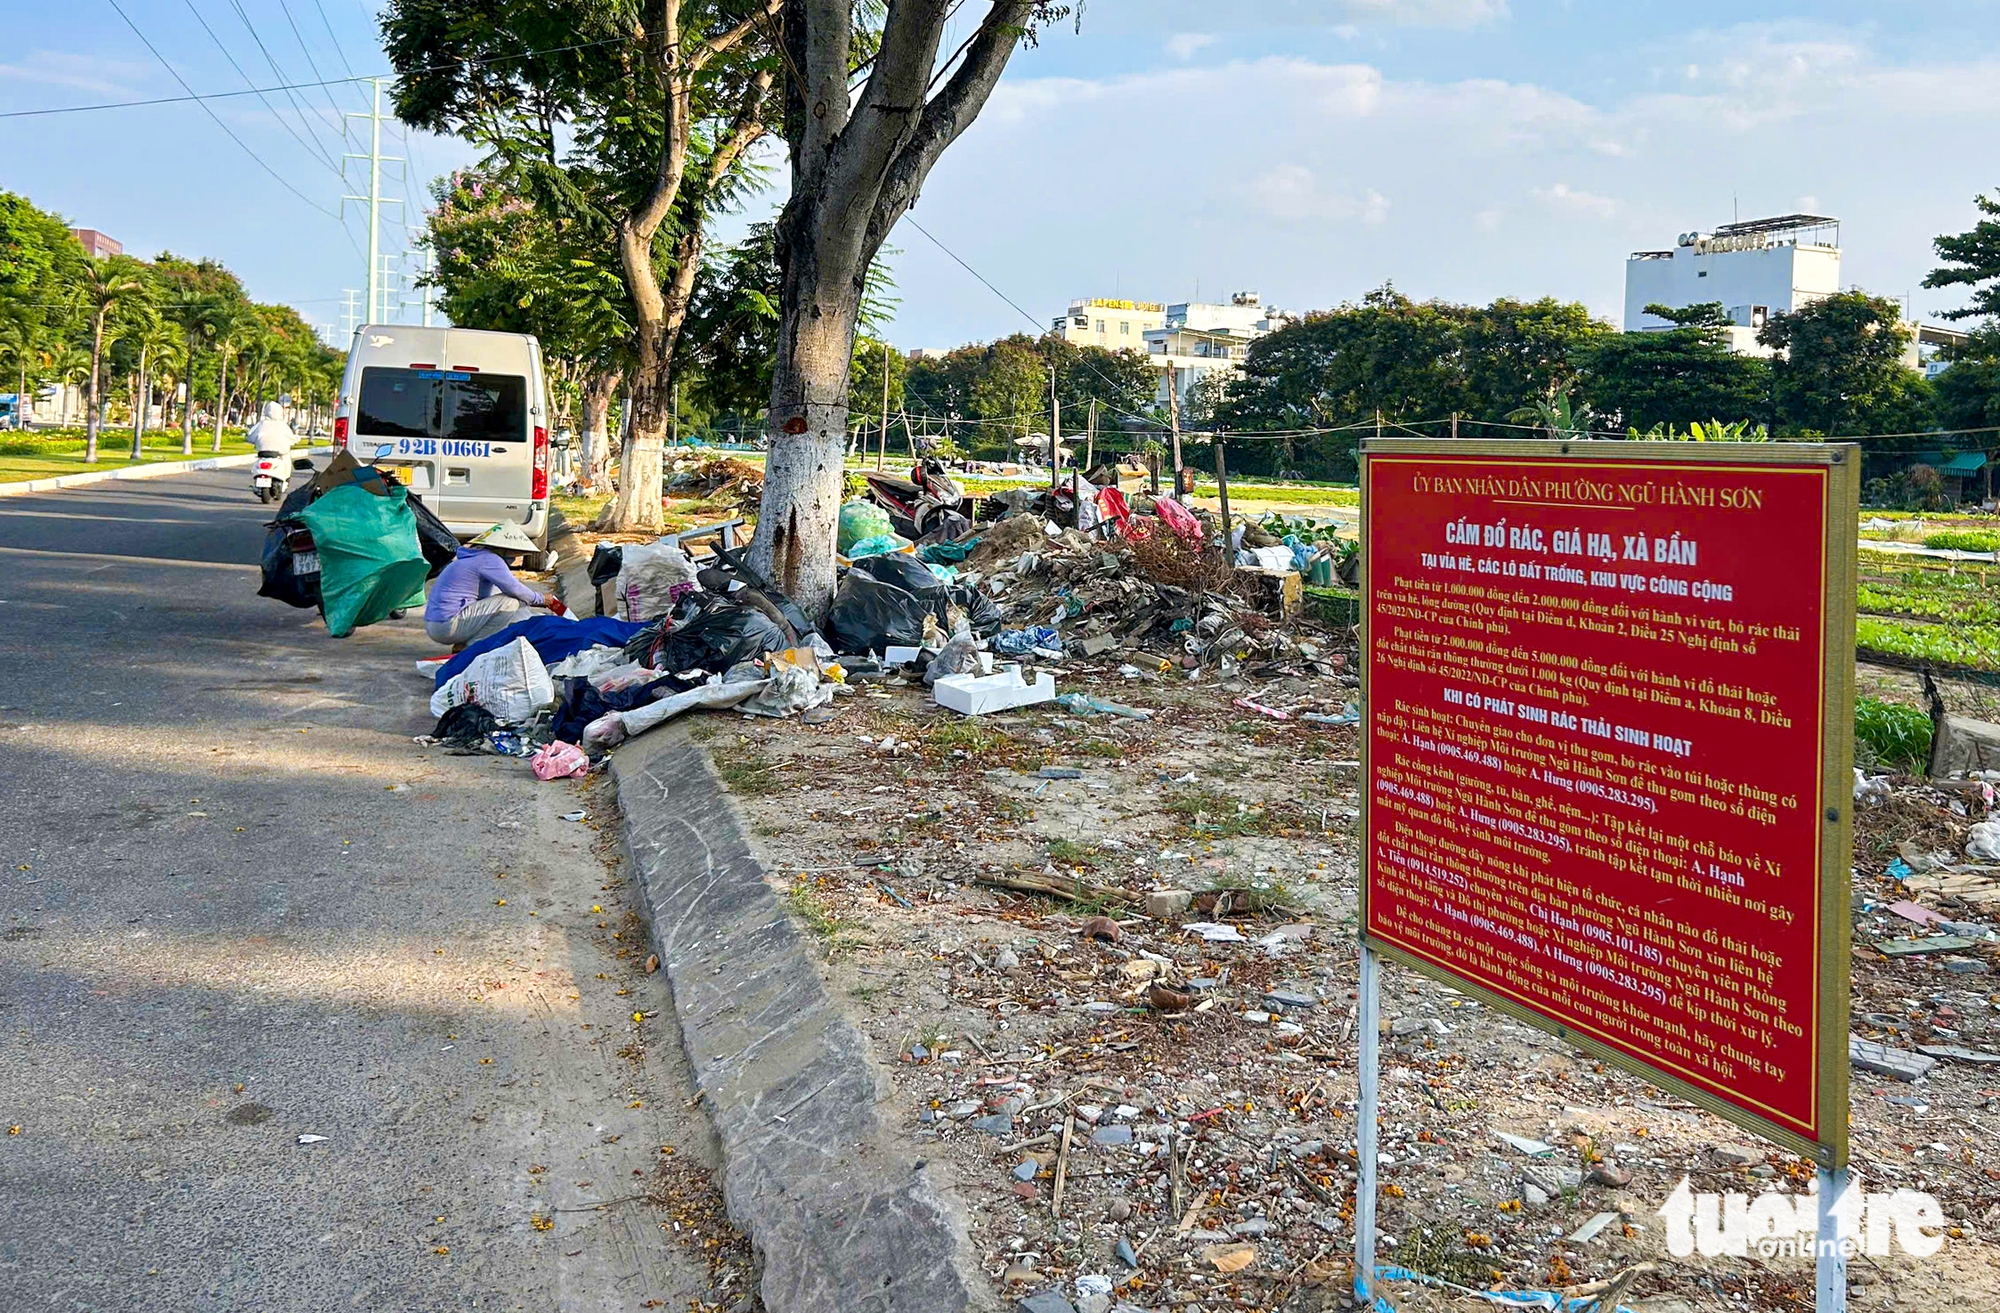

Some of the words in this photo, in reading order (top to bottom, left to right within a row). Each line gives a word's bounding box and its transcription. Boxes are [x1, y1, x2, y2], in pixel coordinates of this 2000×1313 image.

[399, 438, 437, 455] 92B
[442, 440, 491, 458] 01661
[1413, 472, 1430, 492] ỦY
[1434, 477, 1461, 493] BAN
[1465, 474, 1504, 495] NHÂN
[1508, 475, 1540, 496] DÂN
[1545, 477, 1612, 501] PHƯỜNG
[1618, 481, 1655, 503] NGŨ
[1661, 481, 1714, 506] HÀNH
[1719, 486, 1761, 508] SƠN
[1445, 515, 1479, 545] CẤM
[1483, 517, 1505, 547] ĐỔ
[1509, 523, 1547, 554] RÁC,
[1552, 526, 1582, 555] GIÁ
[1587, 532, 1617, 562] HẠ,
[1622, 531, 1648, 561] XÀ
[1654, 530, 1696, 565] BẦN
[1420, 552, 1436, 569] TẠI
[1458, 554, 1475, 573] HÈ,
[1477, 556, 1500, 574] CÁC
[1502, 559, 1516, 576] LÔ
[1518, 559, 1541, 579] ĐẤT
[1543, 562, 1587, 586] TRỐNG,
[1590, 570, 1616, 587] KHU
[1619, 573, 1646, 593] VỰC
[1649, 574, 1688, 596] CÔNG
[1691, 579, 1732, 602] CỘNG
[1631, 606, 1649, 620] với
[1652, 608, 1681, 624] hành
[1685, 613, 1696, 626] vi
[1748, 621, 1769, 636] rác
[1660, 627, 1674, 642] 25
[1678, 630, 1706, 650] Nghị
[1709, 634, 1738, 652] định
[1532, 666, 1556, 682] 1.000
[1559, 671, 1572, 687] kg
[1574, 674, 1600, 693] (Quy
[1604, 679, 1628, 696] định
[1632, 686, 1646, 702] tại
[1630, 667, 1648, 681] với
[1651, 670, 1680, 687] hành
[1683, 676, 1695, 690] vi
[1746, 686, 1776, 706] hoặc
[1443, 687, 1462, 704] KHI
[1465, 691, 1480, 708] CÓ
[1483, 696, 1514, 716] PHÁT
[1517, 703, 1547, 724] SINH
[1550, 710, 1577, 730] RÁC
[1580, 716, 1610, 738] THẢI
[1614, 725, 1649, 747] SINH
[1652, 733, 1692, 757] HOẠT
[1570, 742, 1587, 756] thu
[1638, 759, 1656, 774] rác
[1660, 764, 1681, 779] vào
[1684, 770, 1701, 785] túi
[1704, 773, 1734, 794] hoặc
[1738, 782, 1776, 807] thùng
[1781, 793, 1796, 808] có
[1647, 780, 1666, 795] thu
[1670, 788, 1695, 803] gom
[1699, 793, 1726, 811] theo
[1747, 804, 1776, 825] điện
[1558, 822, 1580, 836] gom
[1584, 827, 1607, 843] theo
[1625, 839, 1649, 859] điện
[1653, 848, 1686, 869] thoại:
[1709, 863, 1744, 886] Hạnh
[1648, 826, 1662, 844] lại
[1666, 834, 1689, 851] một
[1718, 846, 1742, 865] báo
[1765, 859, 1780, 876] Xí
[1608, 853, 1626, 871] tập
[1650, 866, 1672, 883] tạm
[1676, 874, 1700, 892] thời
[1744, 898, 1765, 913] nơi
[1769, 905, 1794, 925] gây
[1616, 916, 1639, 936] Ngũ
[1643, 926, 1674, 949] Hành
[1678, 939, 1701, 959] Sơn
[1706, 951, 1725, 967] xin
[1730, 957, 1752, 977] liên
[1757, 966, 1773, 988] hệ
[1627, 904, 1640, 917] cá
[1643, 910, 1672, 929] nhân
[1676, 921, 1698, 938] nào
[1751, 944, 1782, 968] hoặc
[1582, 922, 1662, 966] (0905.101.185)
[1665, 955, 1708, 980] chuyên
[1712, 973, 1738, 992] viên
[1744, 982, 1786, 1013] Phòng
[1606, 949, 1627, 968] Môi
[1631, 960, 1671, 988] trường
[1675, 975, 1699, 997] Ngũ
[1704, 986, 1738, 1012] Hành
[1743, 1002, 1768, 1024] Sơn
[1773, 1015, 1802, 1036] theo
[1585, 959, 1665, 1005] (0905.283.295)
[1686, 999, 1706, 1021] kịp
[1710, 1011, 1735, 1031] thời
[1573, 1000, 1591, 1015] con
[1595, 1009, 1626, 1031] người
[1630, 1023, 1661, 1048] trong
[1664, 1038, 1690, 1059] toàn
[1695, 1052, 1708, 1066] xã
[1694, 1029, 1716, 1052] hãy
[1764, 1061, 1784, 1082] tay
